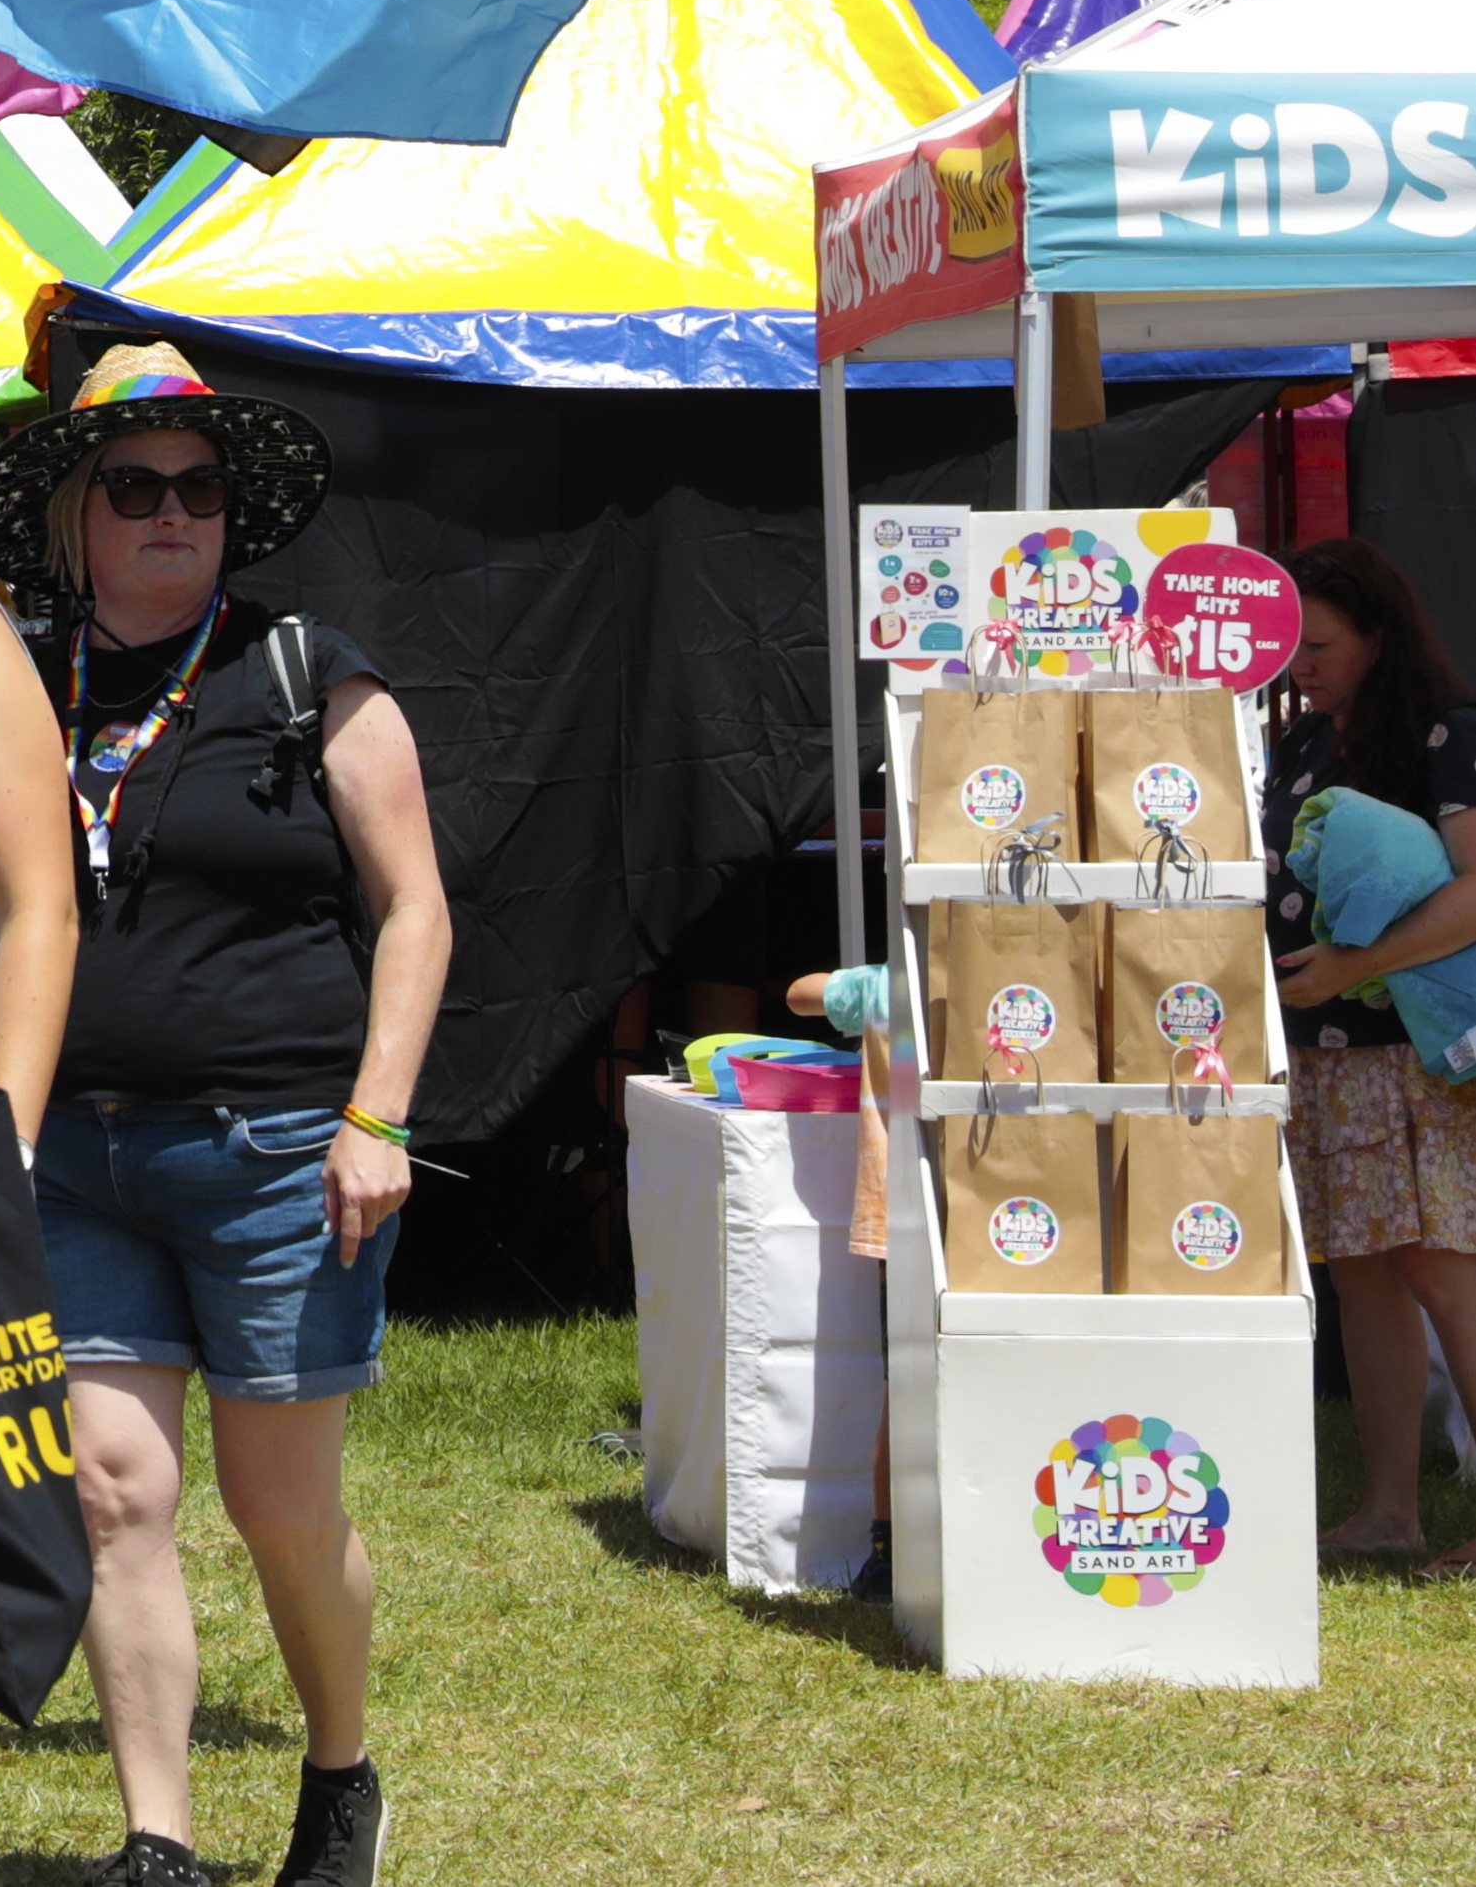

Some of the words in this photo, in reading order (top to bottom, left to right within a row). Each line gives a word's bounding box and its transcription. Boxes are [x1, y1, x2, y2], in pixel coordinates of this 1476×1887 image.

[1109, 101, 1476, 238] KiDS
[1004, 558, 1123, 606] KiDS
[1163, 573, 1215, 593] TAKE
[1222, 576, 1280, 597] HOME
[1196, 595, 1240, 615] KITS
[1074, 636, 1105, 646] ART
[1171, 614, 1252, 673] $15
[1255, 640, 1280, 650] EACH
[972, 780, 1017, 798] KiDS
[1144, 778, 1191, 797] KiDS
[998, 1000, 1045, 1021] KiDS
[1167, 998, 1215, 1018] KiDS
[1000, 1213, 1049, 1233] KiDS
[1183, 1217, 1232, 1238] KiDS
[1053, 1454, 1208, 1515] KiDS
[1057, 1515, 1210, 1546] KREATiVE
[1078, 1556, 1135, 1569] SAND
[1146, 1555, 1187, 1568] ART
